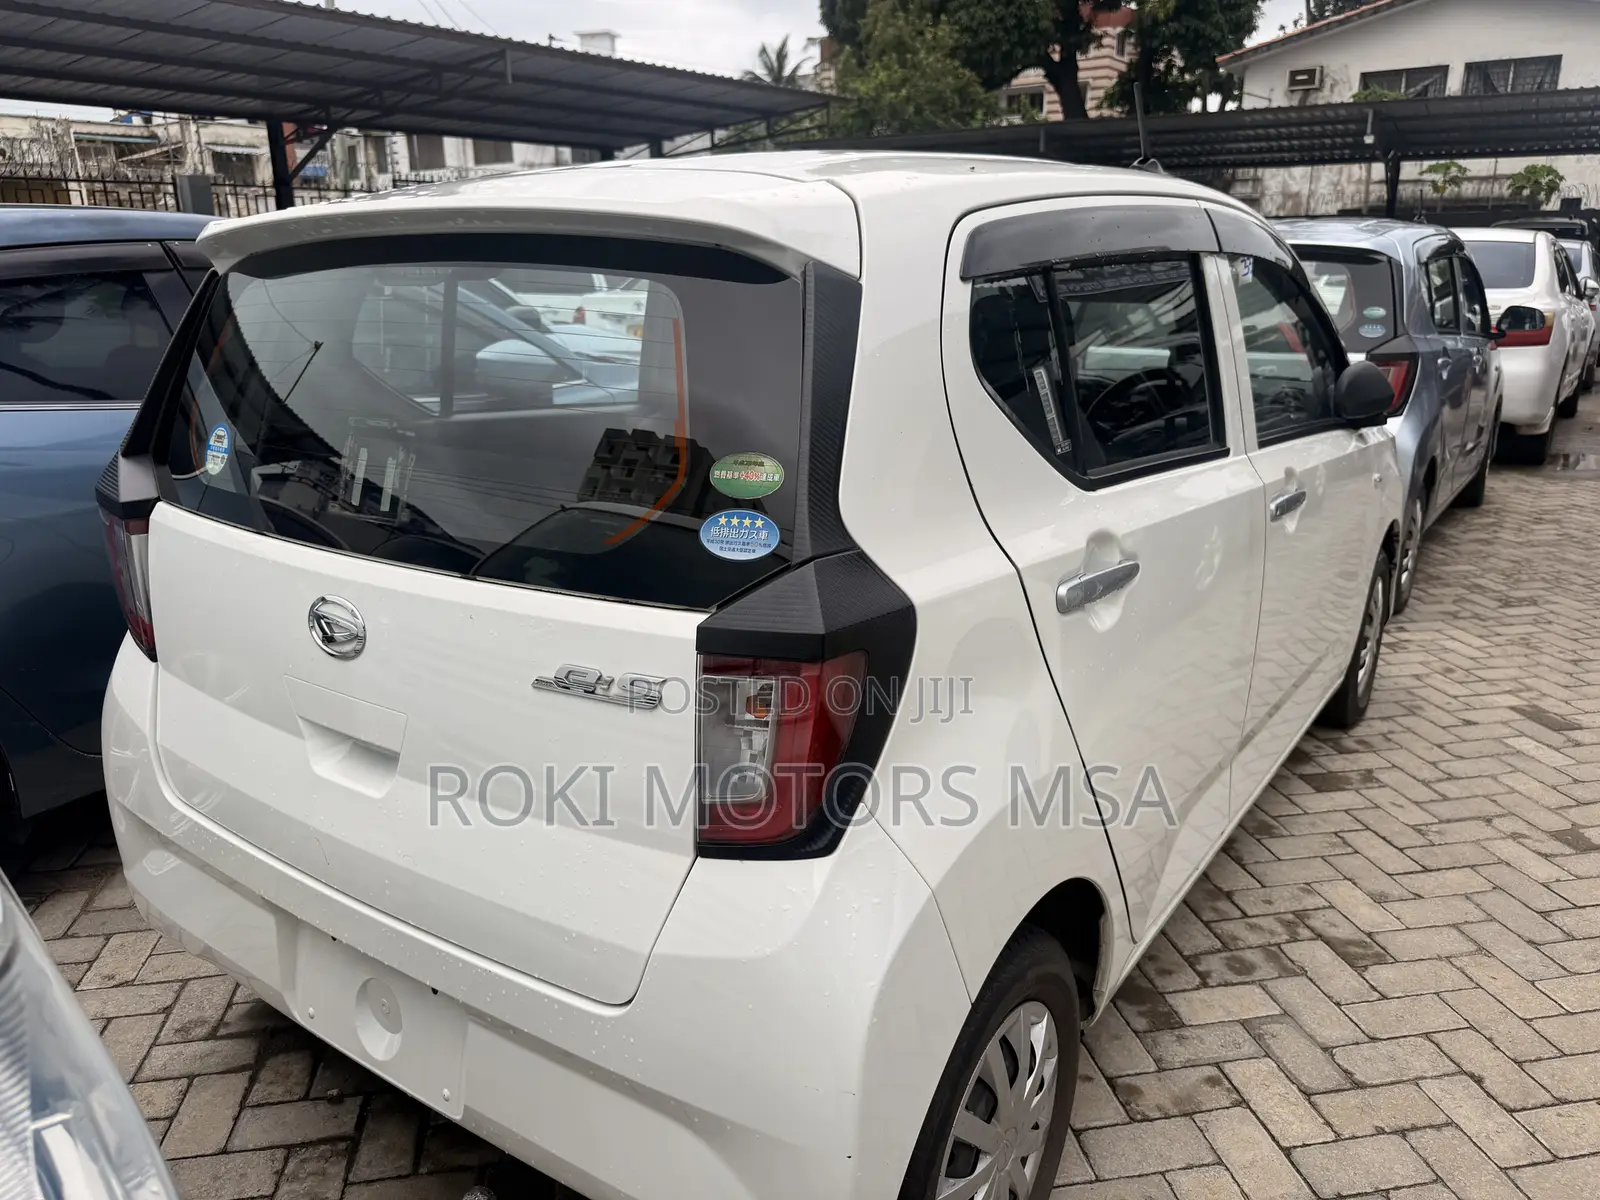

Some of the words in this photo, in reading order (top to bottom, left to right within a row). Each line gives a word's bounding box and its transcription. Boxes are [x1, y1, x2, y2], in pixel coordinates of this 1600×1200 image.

[710, 526, 769, 541] 低排出ガス車
